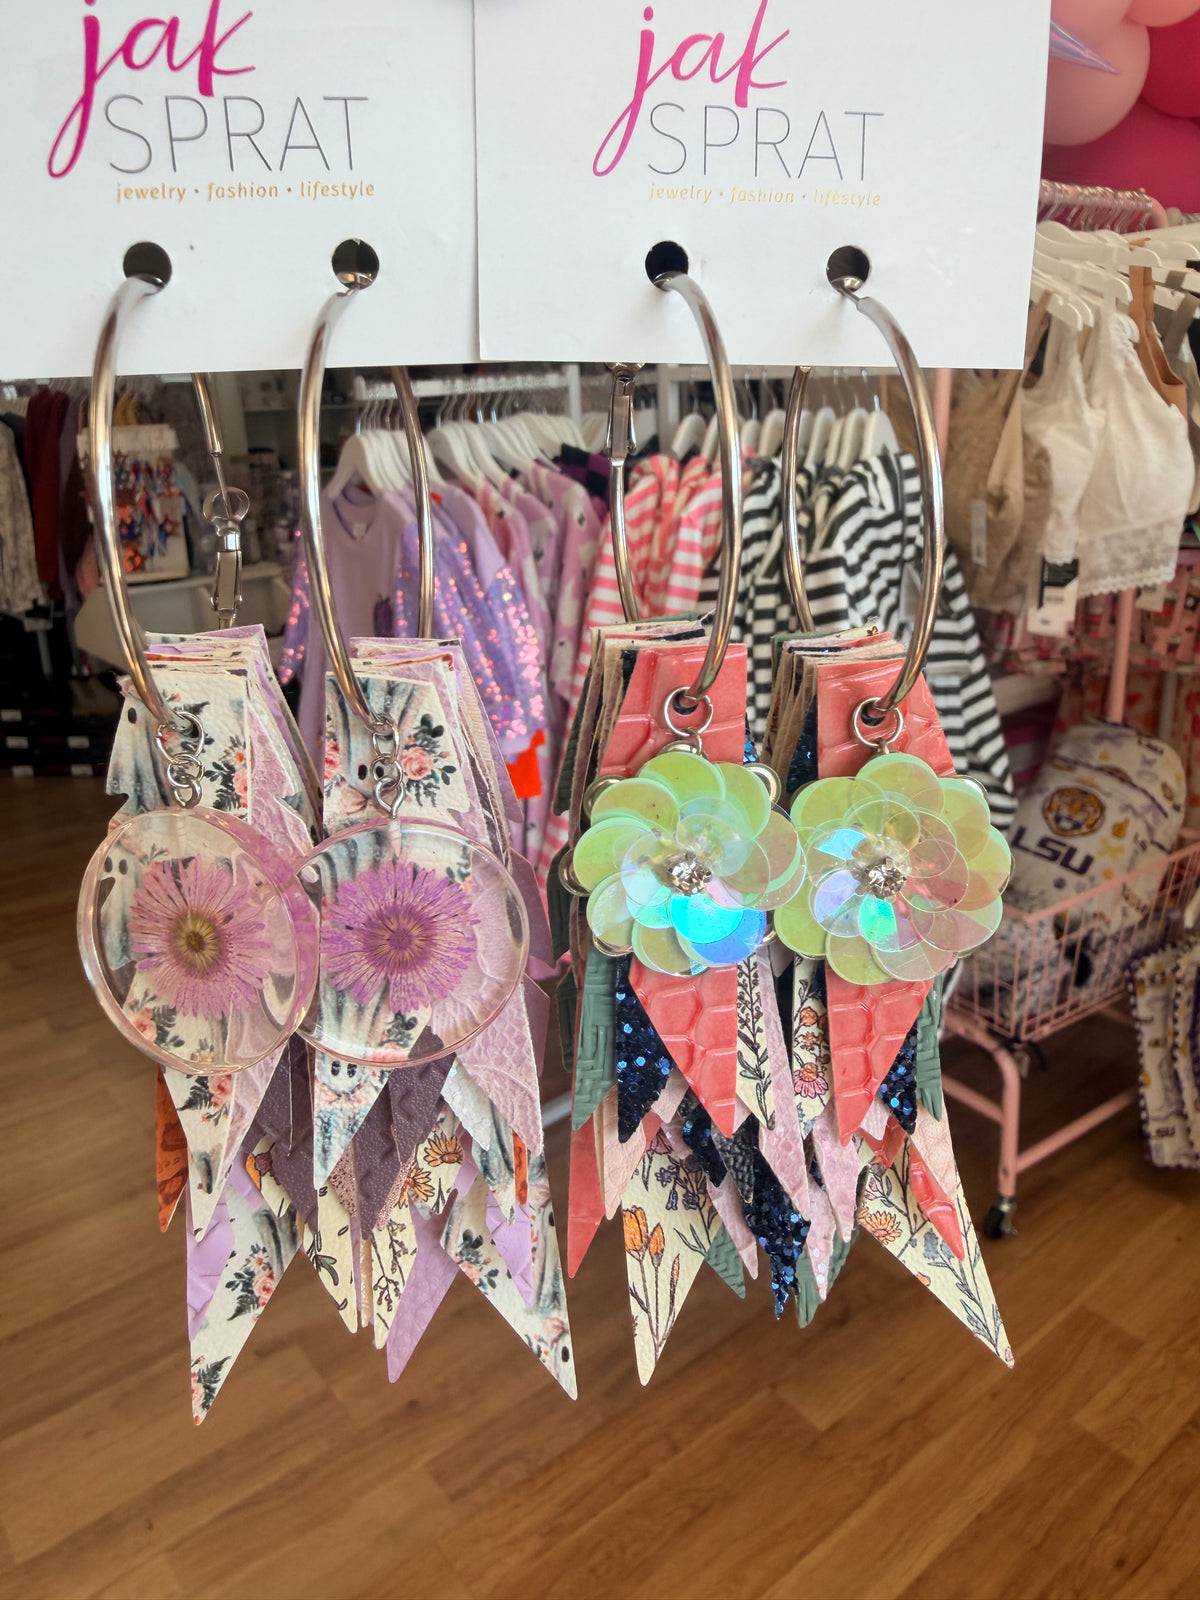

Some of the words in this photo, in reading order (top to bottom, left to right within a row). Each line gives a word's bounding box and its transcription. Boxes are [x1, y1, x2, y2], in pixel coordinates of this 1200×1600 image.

[48, 0, 256, 178] jak
[593, 0, 790, 177] jak
[104, 94, 369, 174] SPRAT
[647, 102, 885, 181] SPRAT
[115, 182, 187, 203] jewelry
[207, 182, 279, 202] fashion
[299, 179, 376, 201] lifestyle
[649, 183, 713, 204] jewelry
[729, 186, 795, 205] fashion
[812, 188, 882, 208] lifestyle
[1010, 825, 1094, 875] LSU
